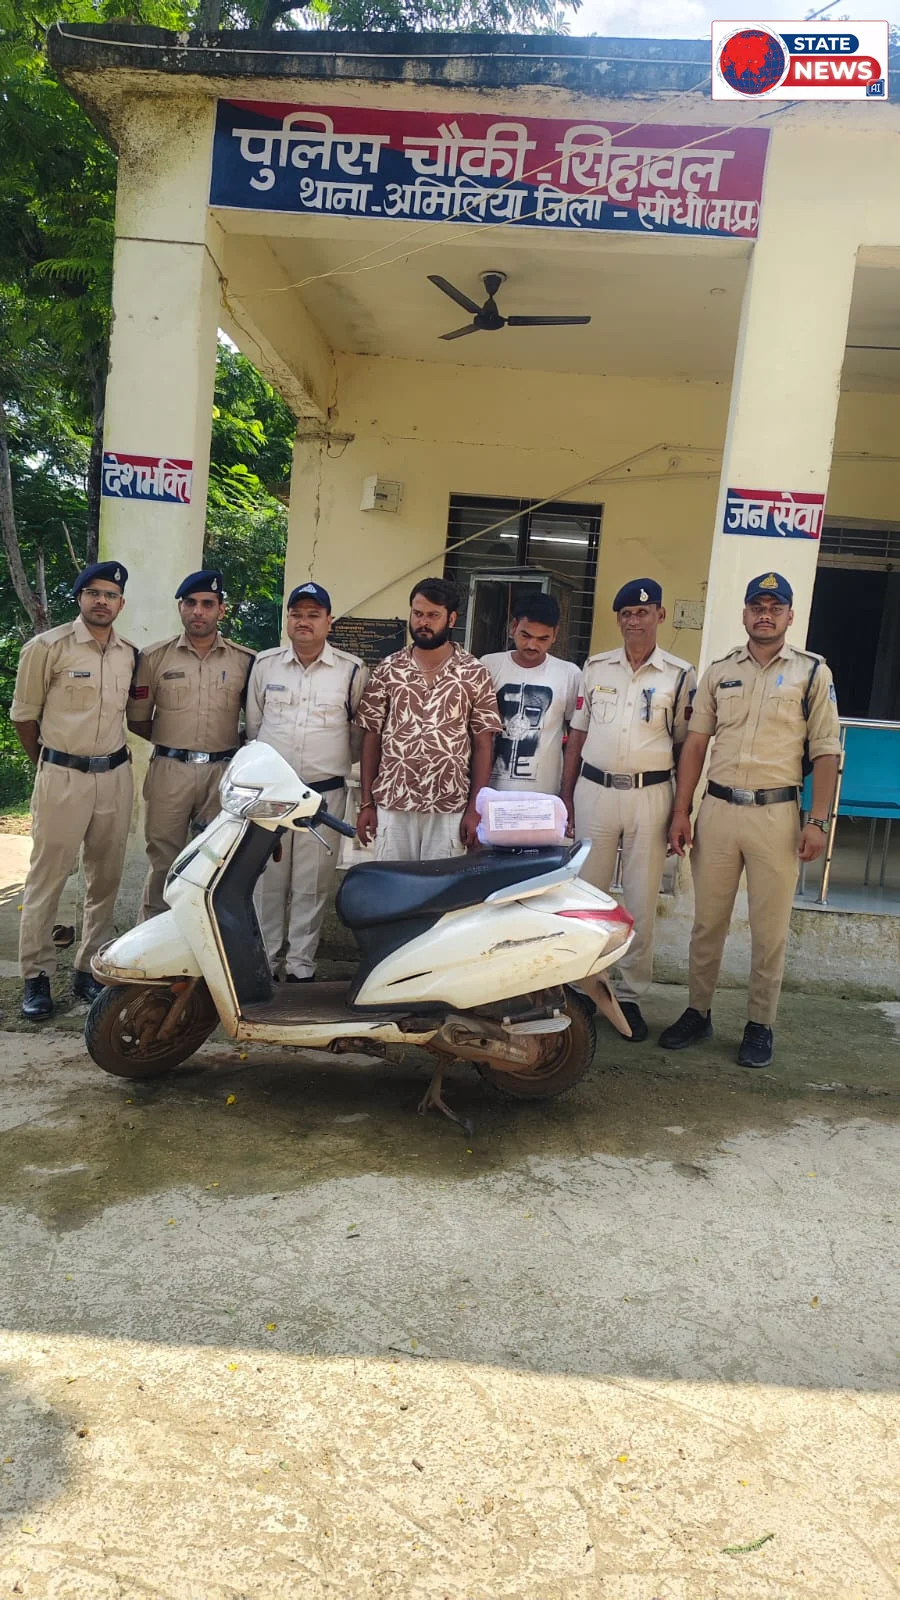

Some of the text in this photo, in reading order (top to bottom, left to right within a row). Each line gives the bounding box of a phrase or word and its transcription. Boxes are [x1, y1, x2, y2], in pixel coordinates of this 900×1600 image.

[231, 111, 390, 191] पुलिस
[402, 120, 537, 182] चौकी
[300, 177, 374, 213] थाना
[533, 183, 609, 227] जिला
[103, 454, 192, 503] देशभक्ति
[727, 492, 823, 537] जन सेवा
